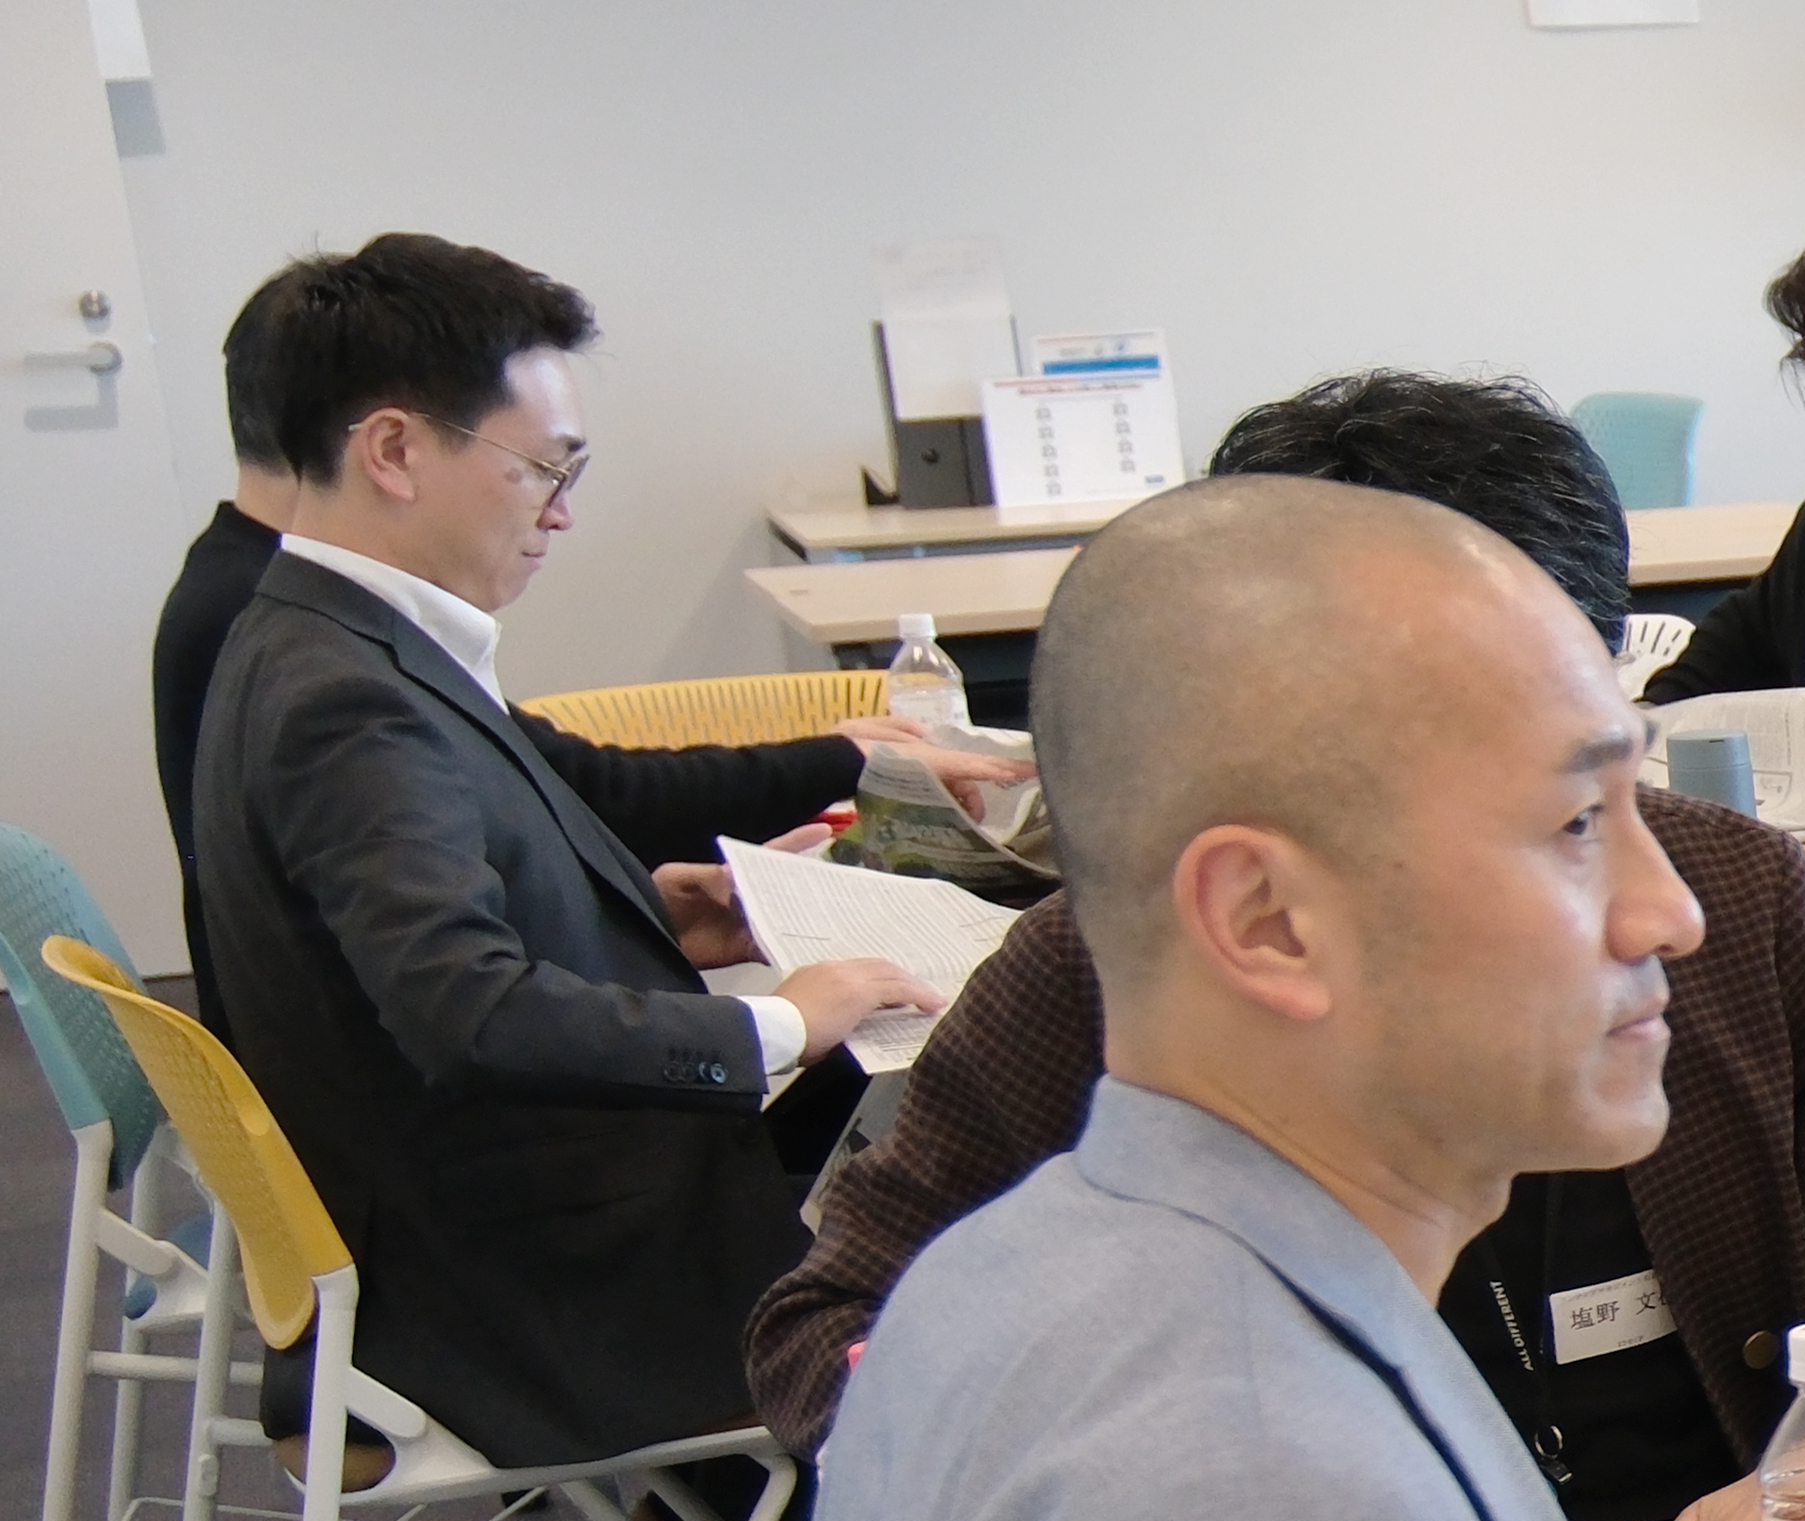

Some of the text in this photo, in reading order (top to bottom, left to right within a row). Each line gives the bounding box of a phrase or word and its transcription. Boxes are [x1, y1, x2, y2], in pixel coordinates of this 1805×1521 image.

[1490, 1281, 1534, 1372] ALL DIFFERENT
[1571, 1300, 1620, 1330] 塩野
